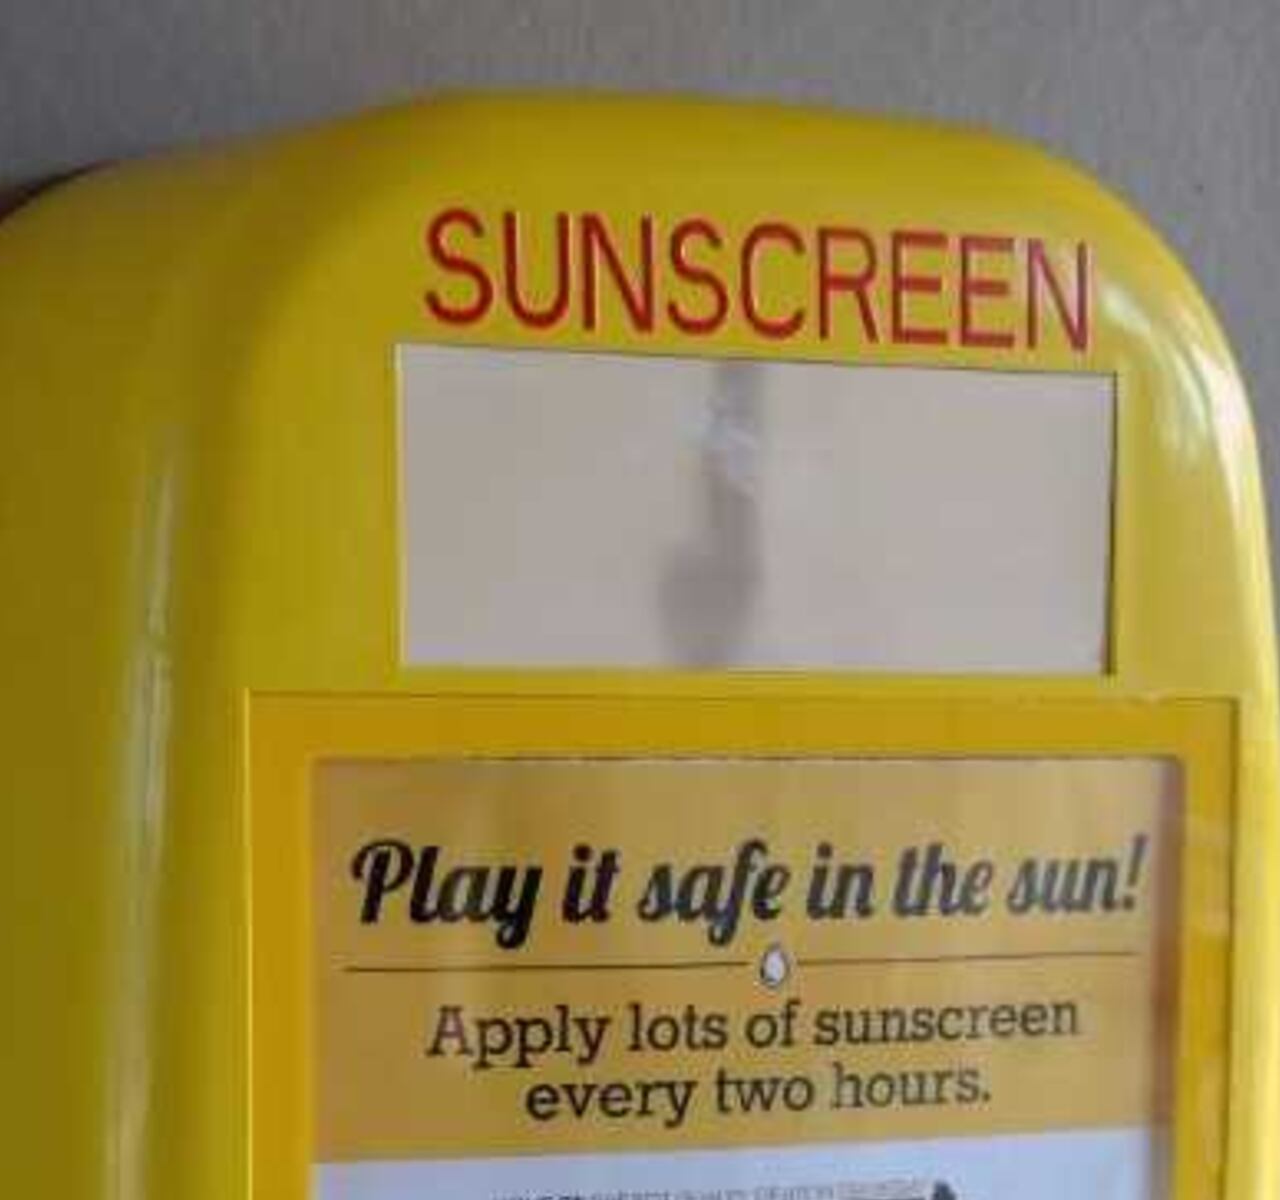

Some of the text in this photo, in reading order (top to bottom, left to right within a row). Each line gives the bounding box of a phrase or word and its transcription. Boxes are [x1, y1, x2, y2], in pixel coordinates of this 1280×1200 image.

[424, 208, 1096, 353] SUNSCREEN
[350, 834, 1150, 949] Play it safe in the sun!
[427, 998, 1080, 1071] Apply lots of sunscreen
[525, 1062, 993, 1127] every two hours.
